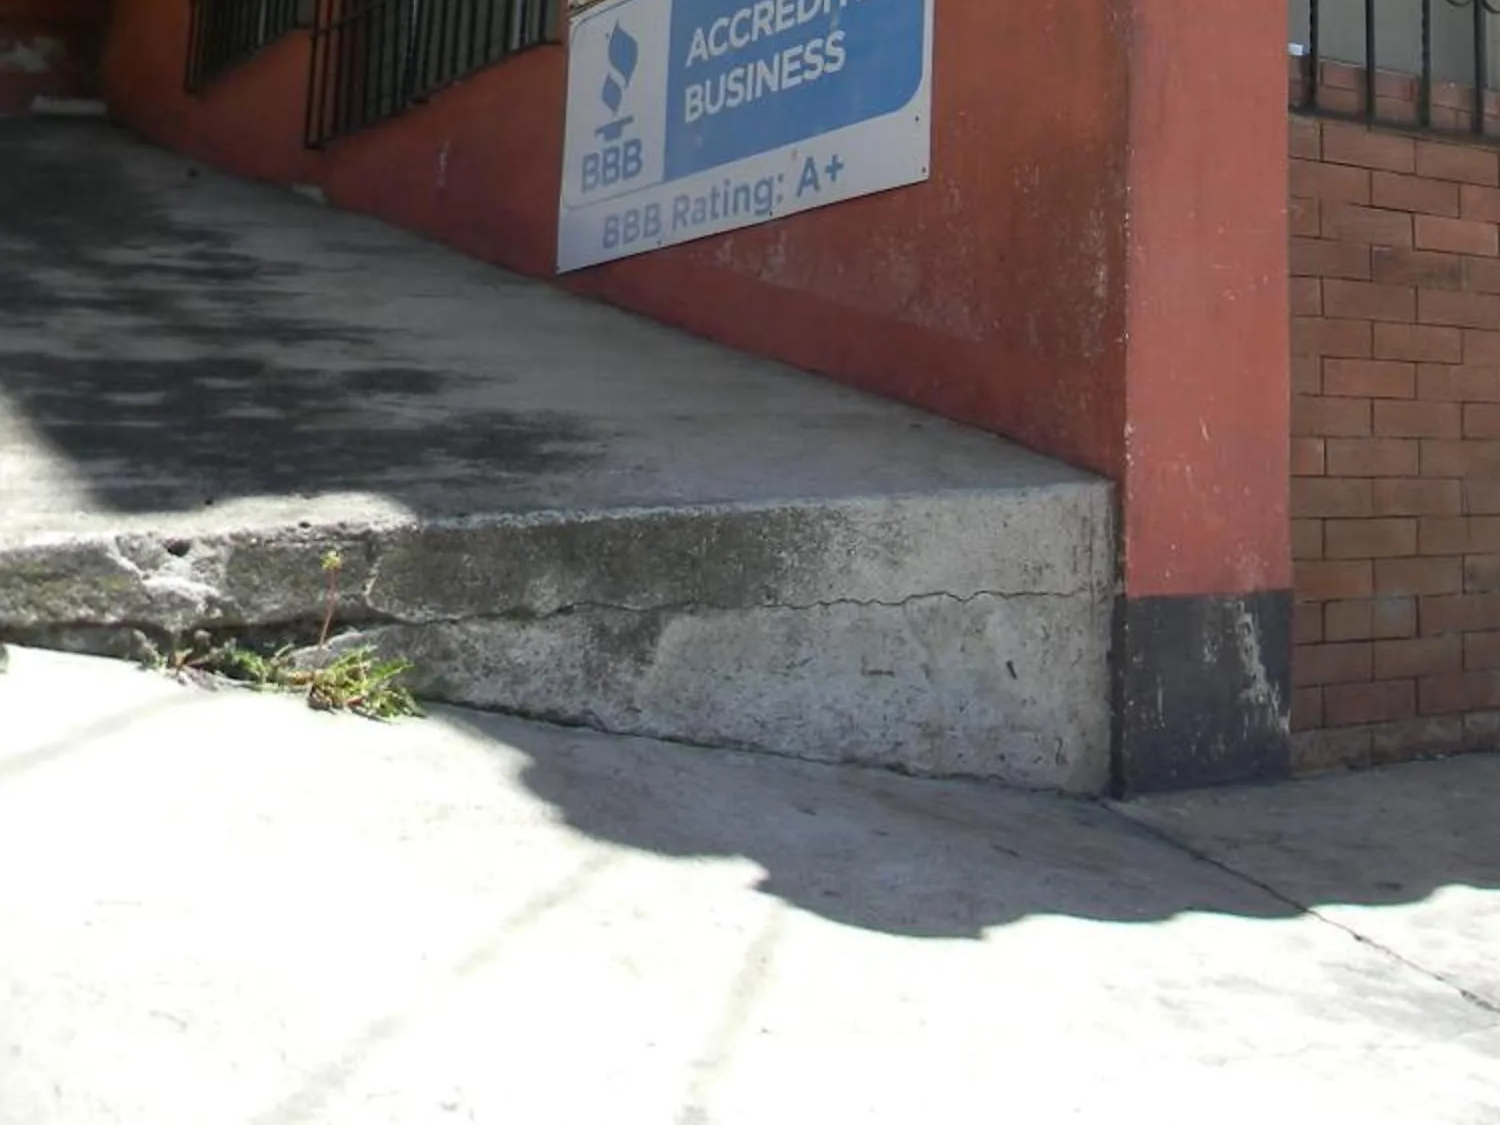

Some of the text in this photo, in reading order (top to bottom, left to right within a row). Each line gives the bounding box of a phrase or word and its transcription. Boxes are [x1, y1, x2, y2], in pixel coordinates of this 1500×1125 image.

[684, 29, 847, 124] BUSINESS
[580, 137, 644, 194] BBB
[602, 151, 845, 250] BBB Rating: A+
